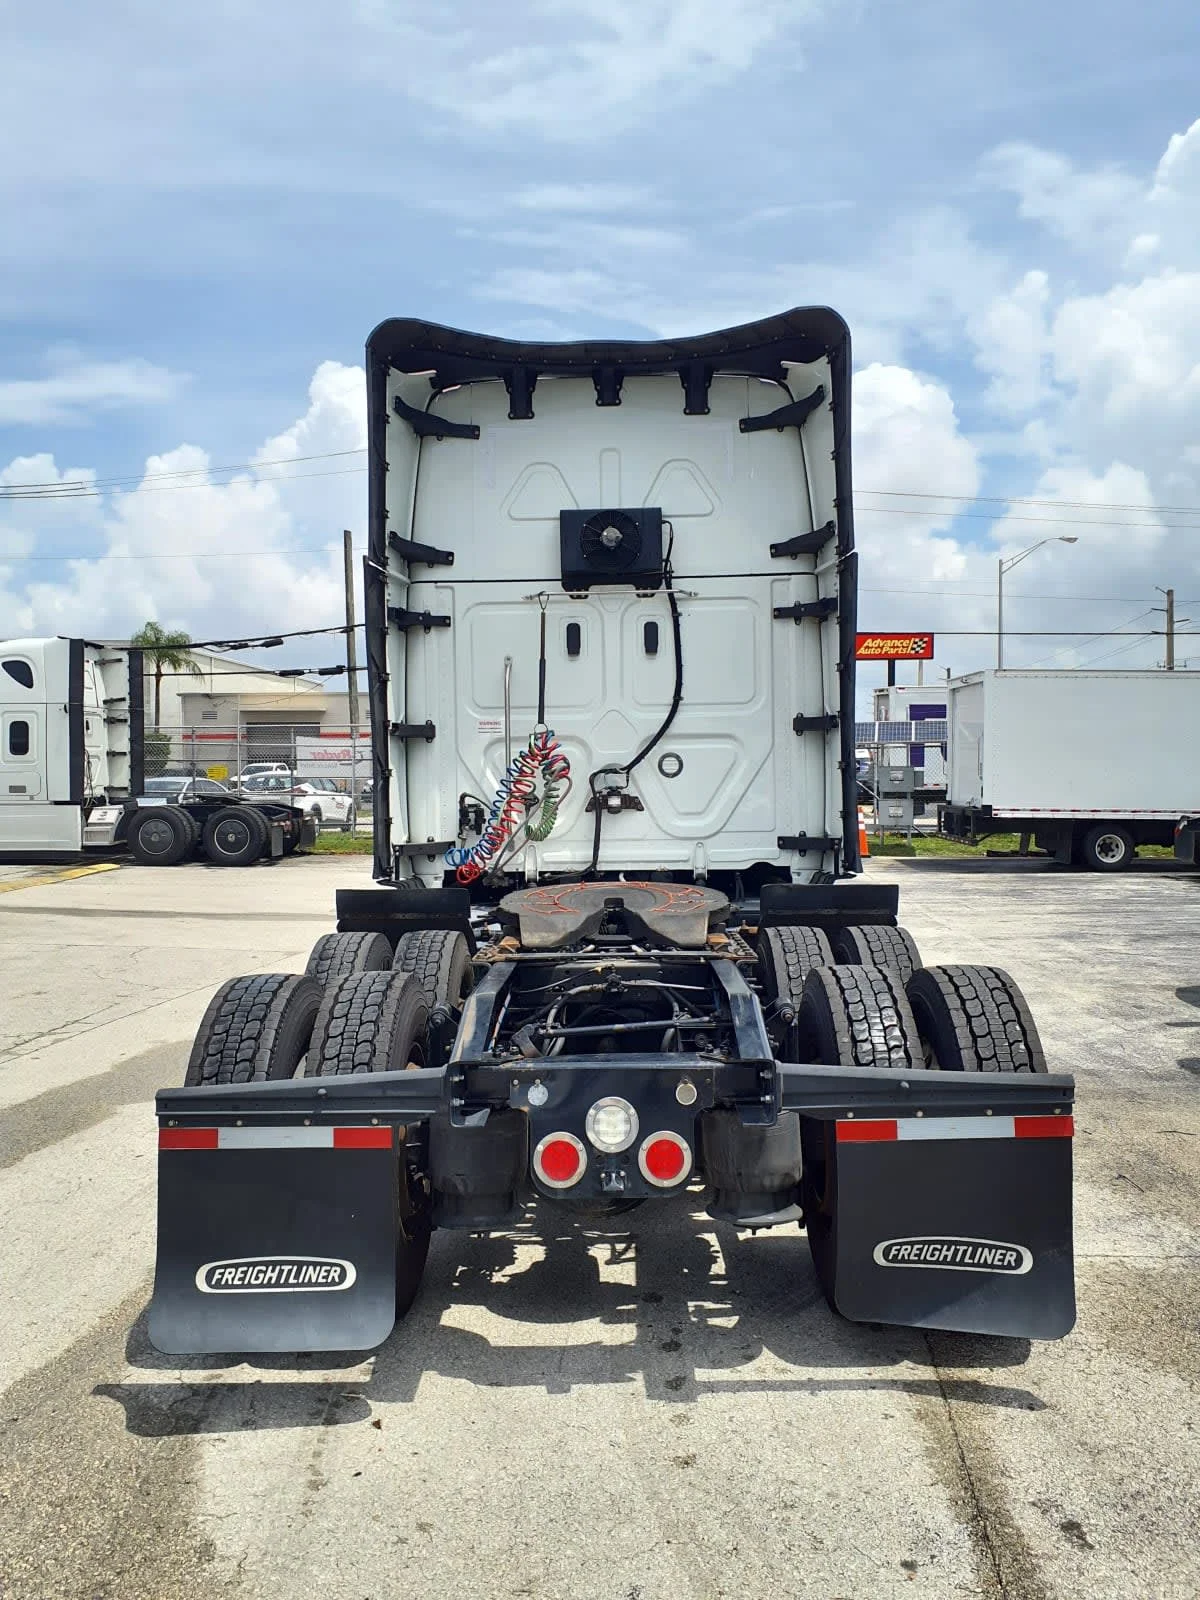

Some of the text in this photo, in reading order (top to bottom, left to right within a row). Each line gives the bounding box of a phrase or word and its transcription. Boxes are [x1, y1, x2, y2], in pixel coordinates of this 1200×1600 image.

[863, 638, 909, 647] Advance
[856, 646, 907, 654] Auto Parts
[888, 1244, 1017, 1266] FREIGHTLINER
[211, 1265, 341, 1285] FREIGHTLINER
